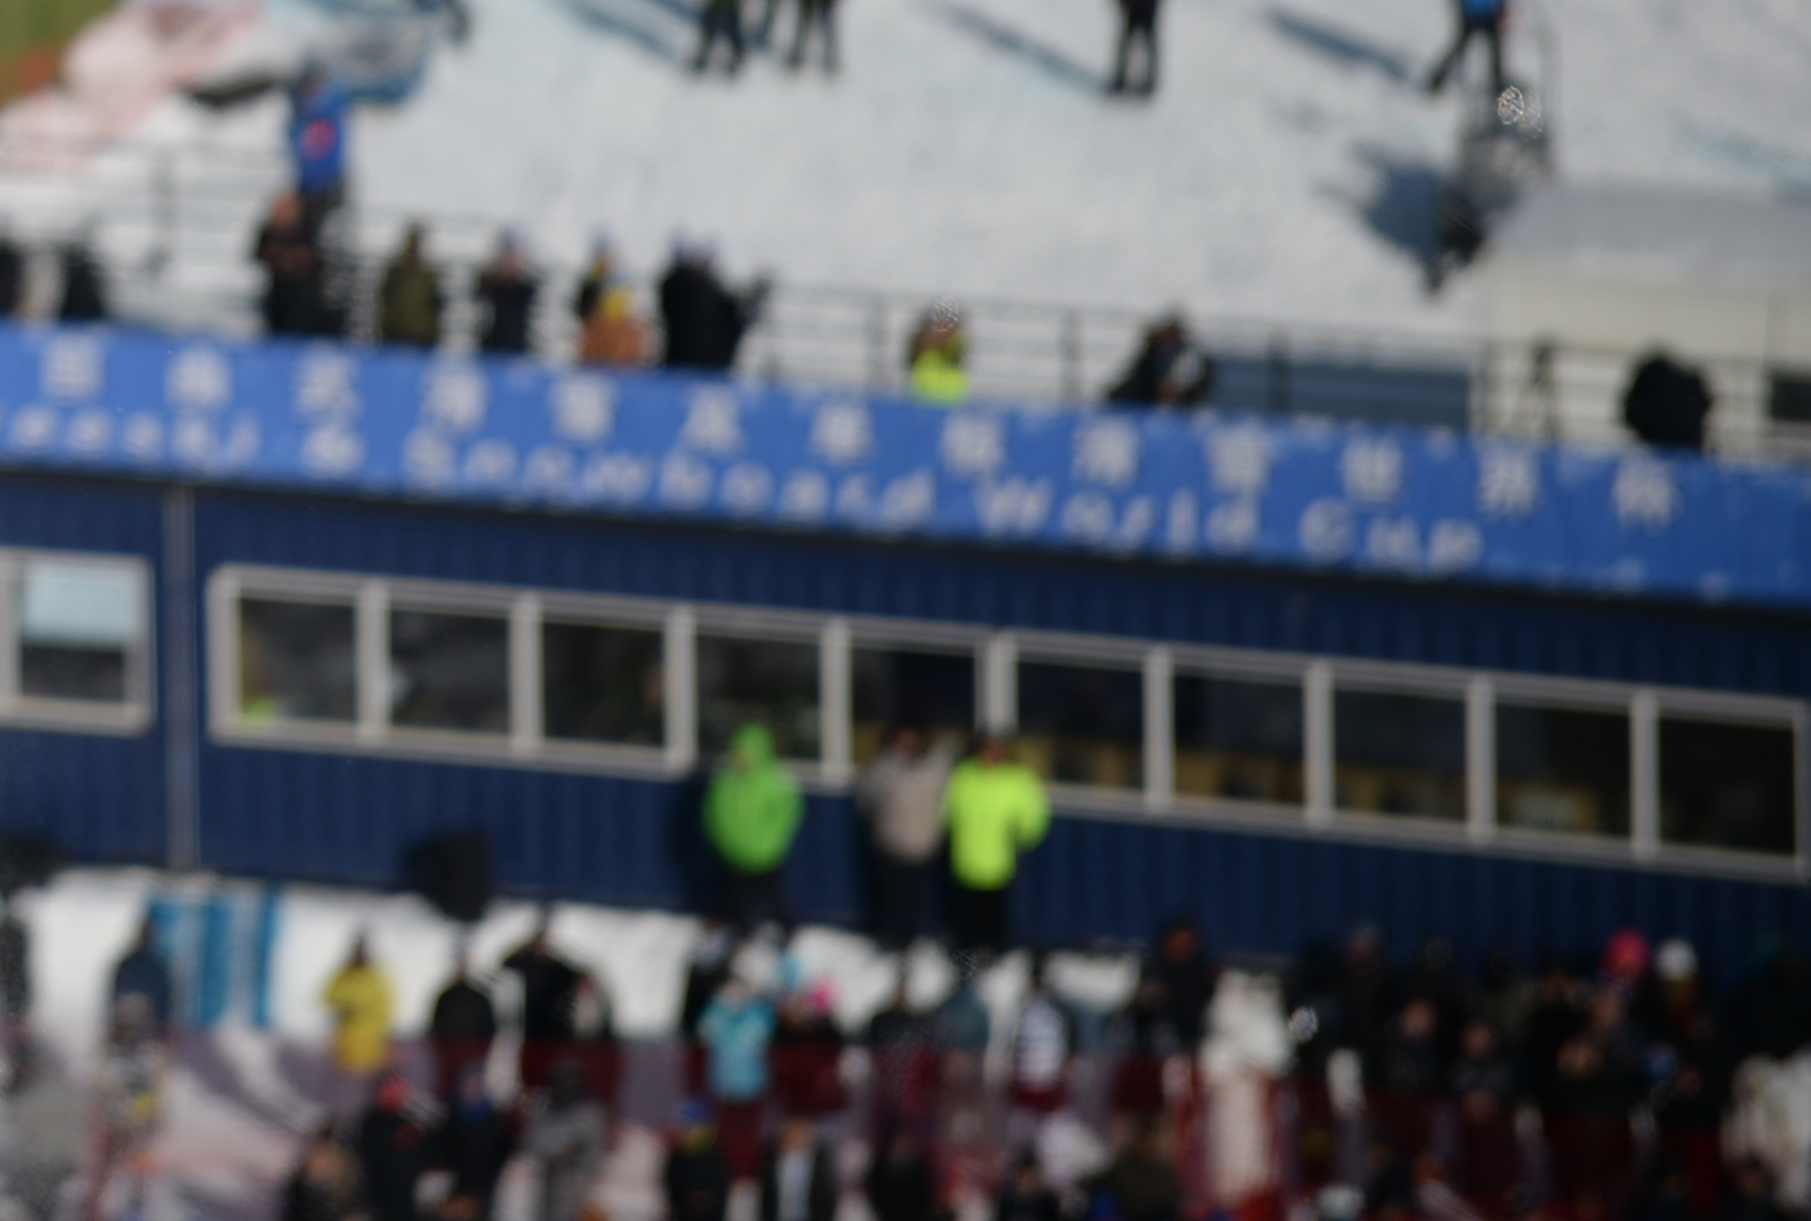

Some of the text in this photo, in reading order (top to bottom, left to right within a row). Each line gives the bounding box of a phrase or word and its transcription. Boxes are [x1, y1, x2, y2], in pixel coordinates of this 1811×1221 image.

[401, 424, 936, 530] Snowboard
[974, 470, 1263, 559] World
[1298, 498, 1486, 573] Cup
